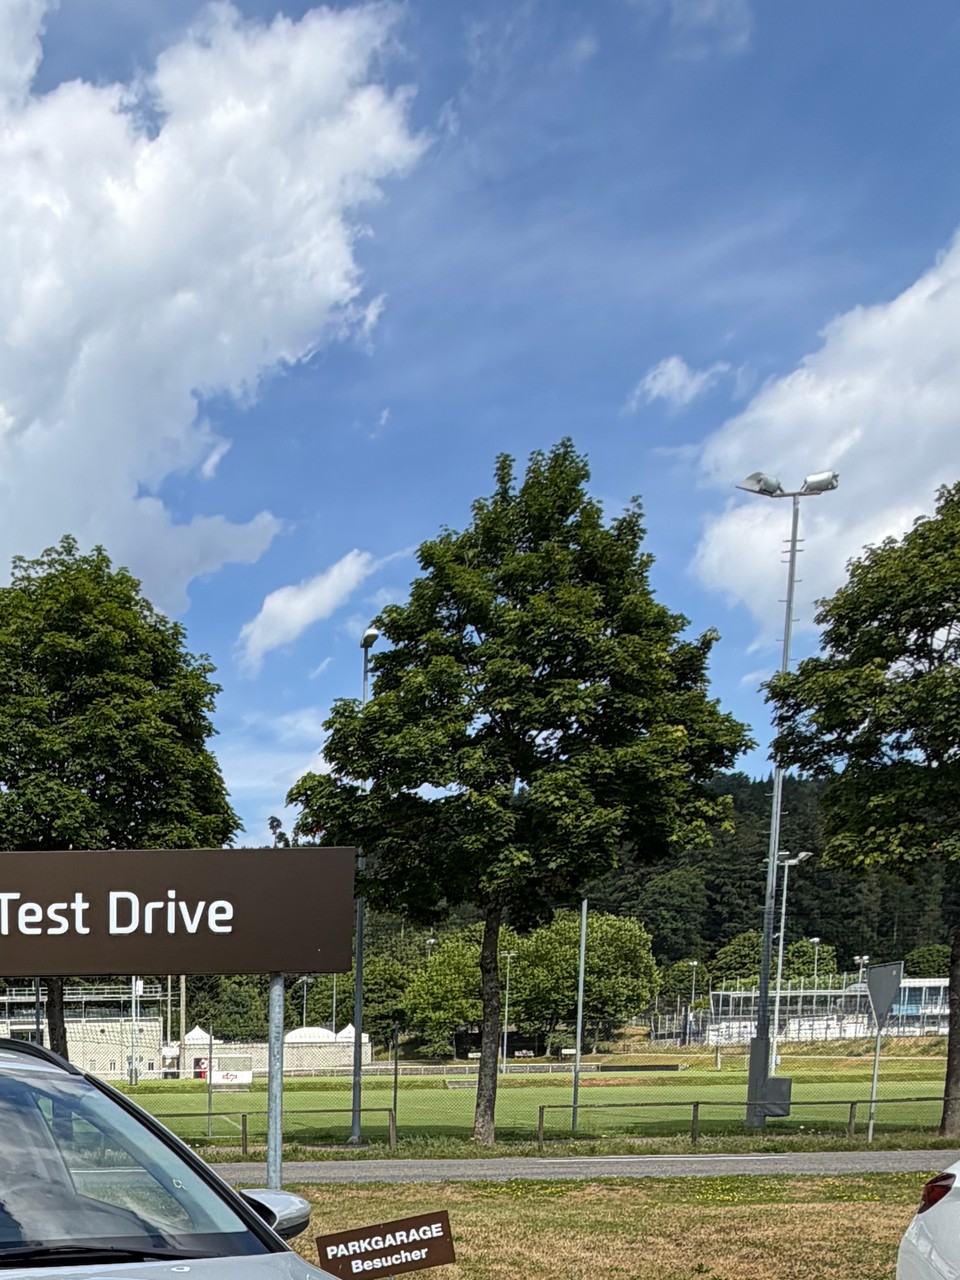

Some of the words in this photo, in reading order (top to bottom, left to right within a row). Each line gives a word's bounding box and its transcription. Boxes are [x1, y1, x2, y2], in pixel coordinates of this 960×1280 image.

[109, 889, 234, 935] Drive
[326, 1223, 444, 1260] PARKGARAGE
[351, 1248, 429, 1273] Besucher
